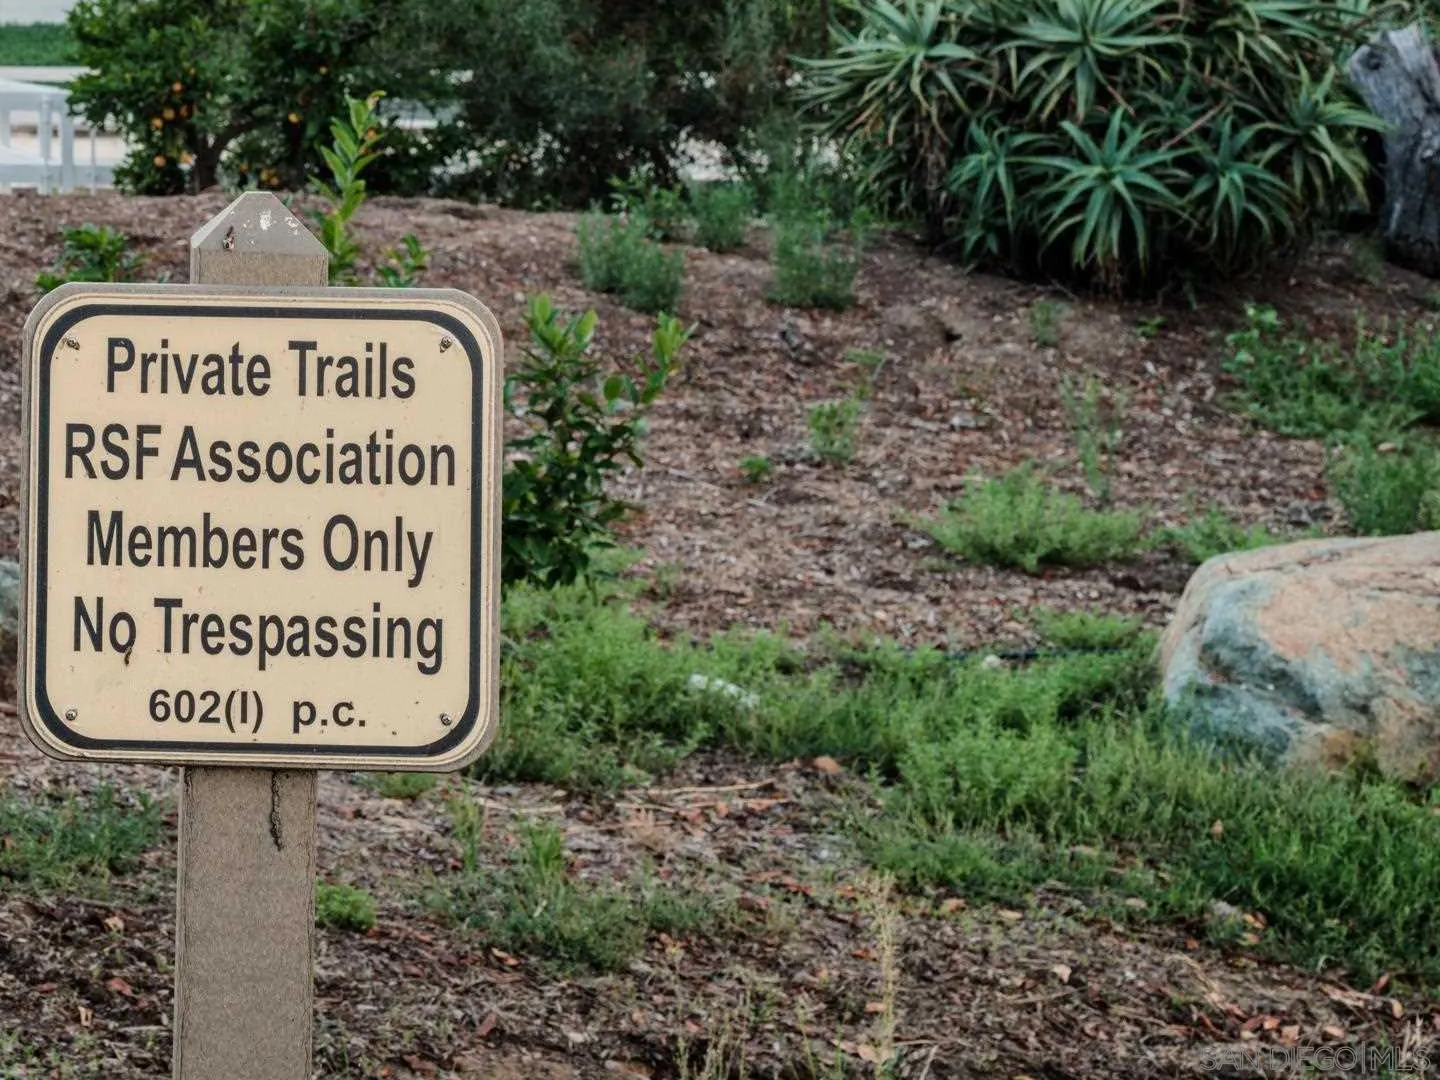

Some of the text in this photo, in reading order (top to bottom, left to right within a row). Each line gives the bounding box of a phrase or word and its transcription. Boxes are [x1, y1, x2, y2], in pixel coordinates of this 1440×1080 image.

[106, 337, 415, 399] Private Trails
[65, 424, 455, 486] RSF Association
[87, 511, 433, 587] Members Only
[74, 597, 443, 674] No Trespassing
[293, 701, 366, 732] p.c.
